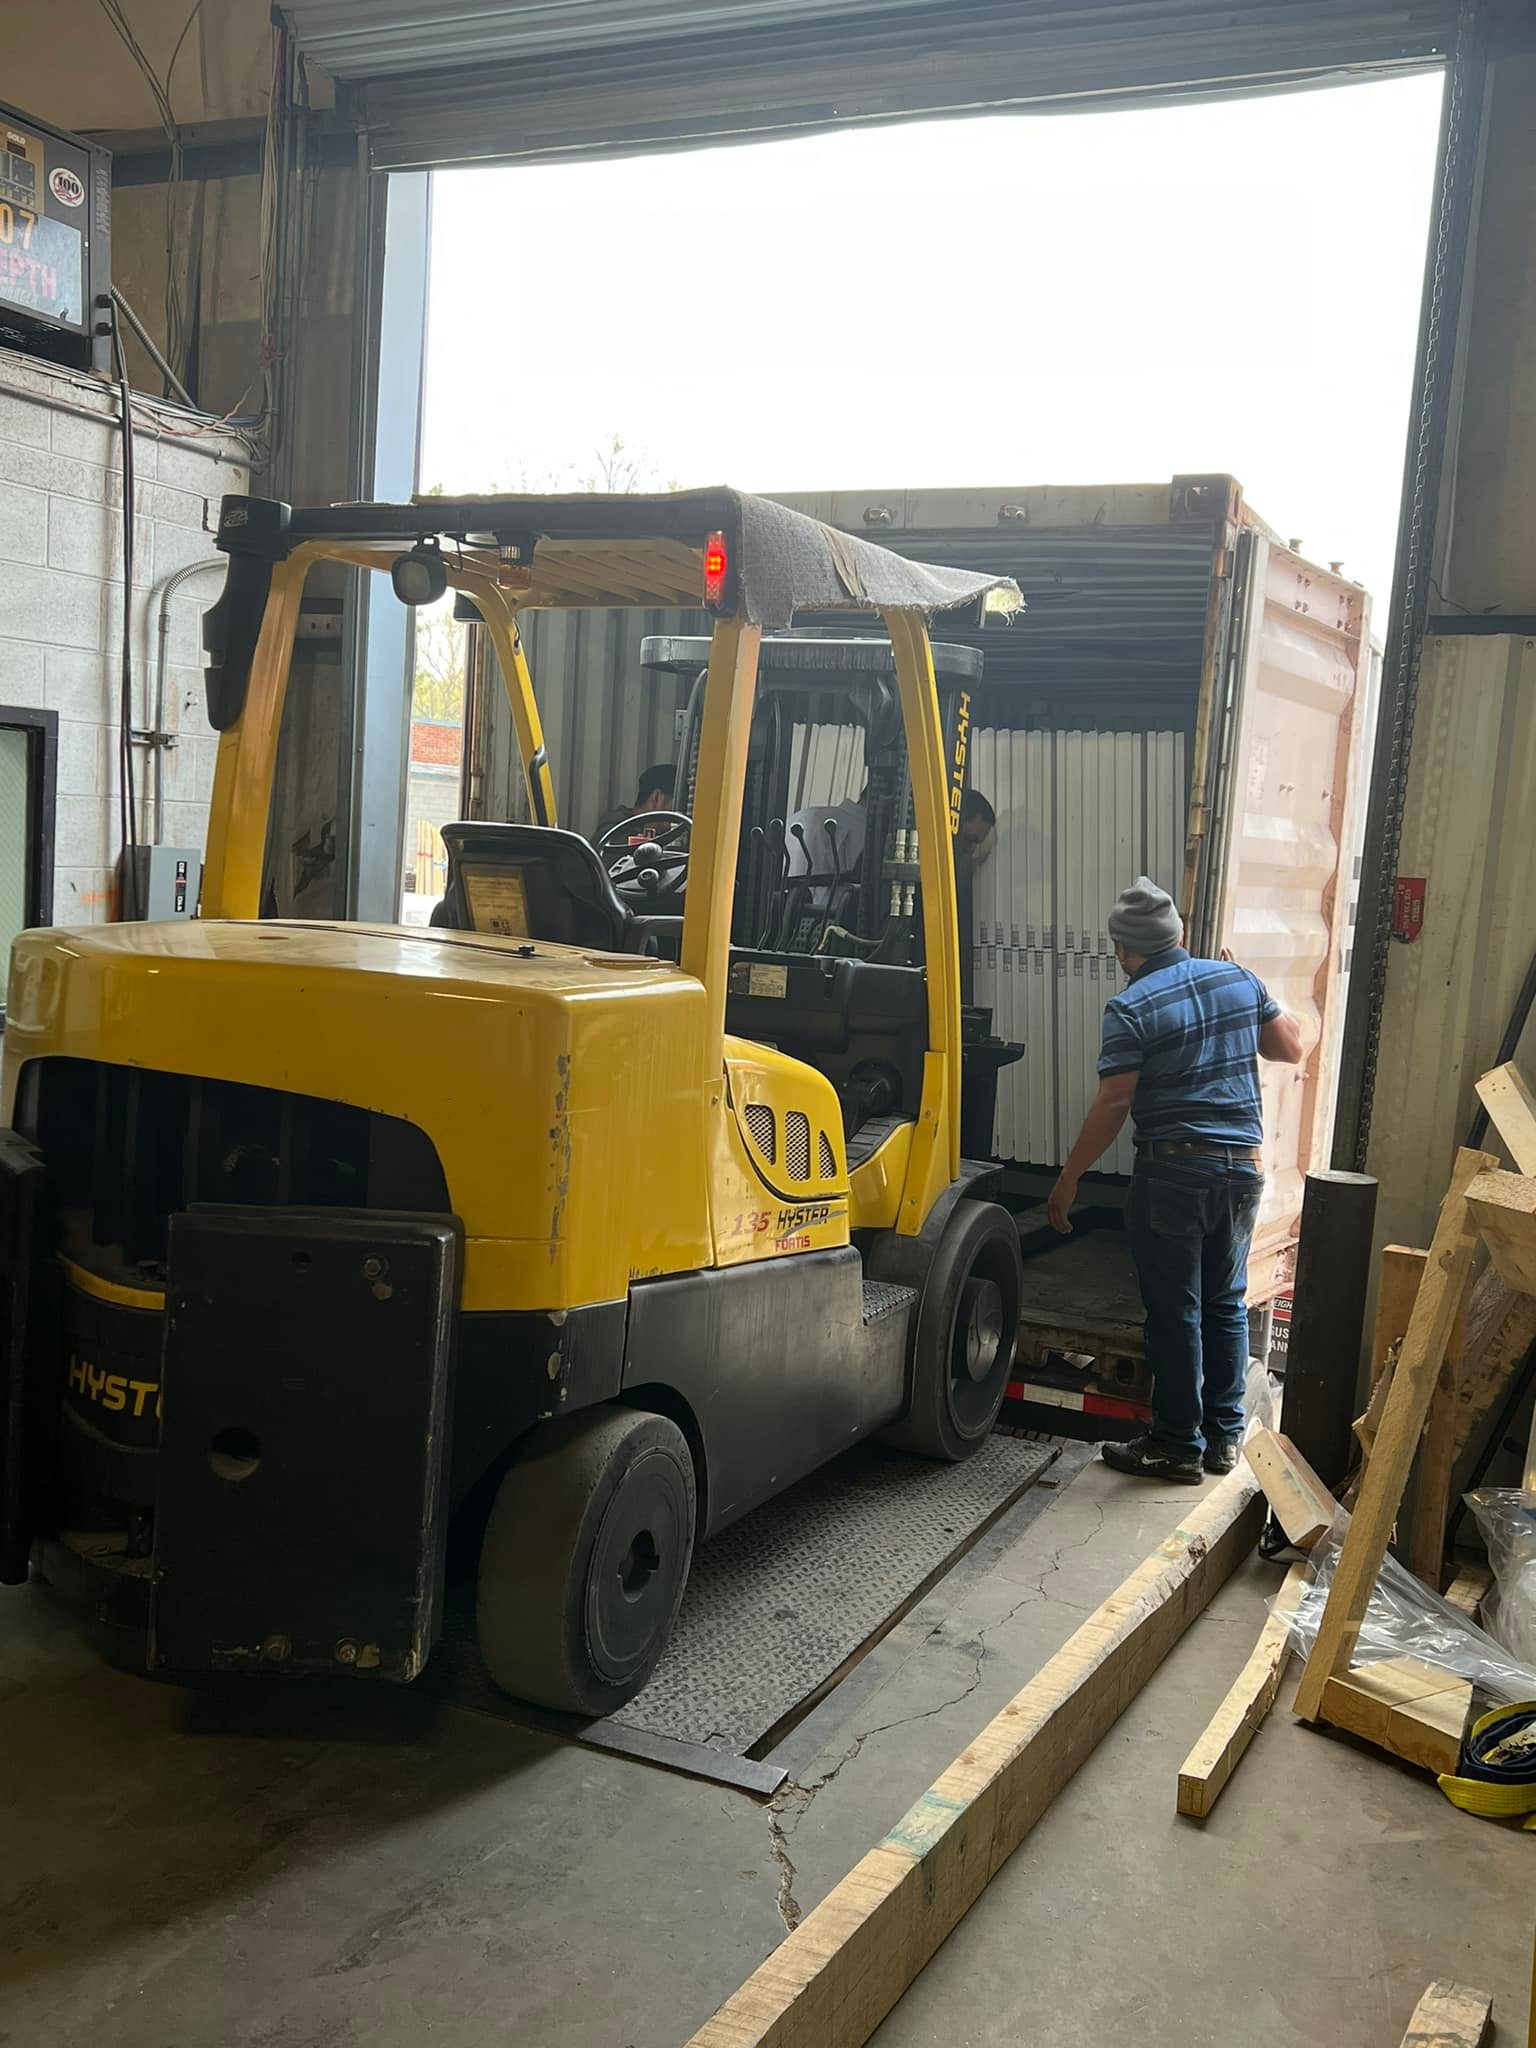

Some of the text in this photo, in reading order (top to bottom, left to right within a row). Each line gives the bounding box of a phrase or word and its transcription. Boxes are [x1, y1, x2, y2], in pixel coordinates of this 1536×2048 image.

[7, 131, 26, 145] GOLD
[58, 175, 80, 195] 100
[949, 691, 971, 835] HYSTER
[732, 1211, 772, 1236] 135
[775, 1236, 811, 1252] FORTIS
[70, 1354, 162, 1420] HYST
